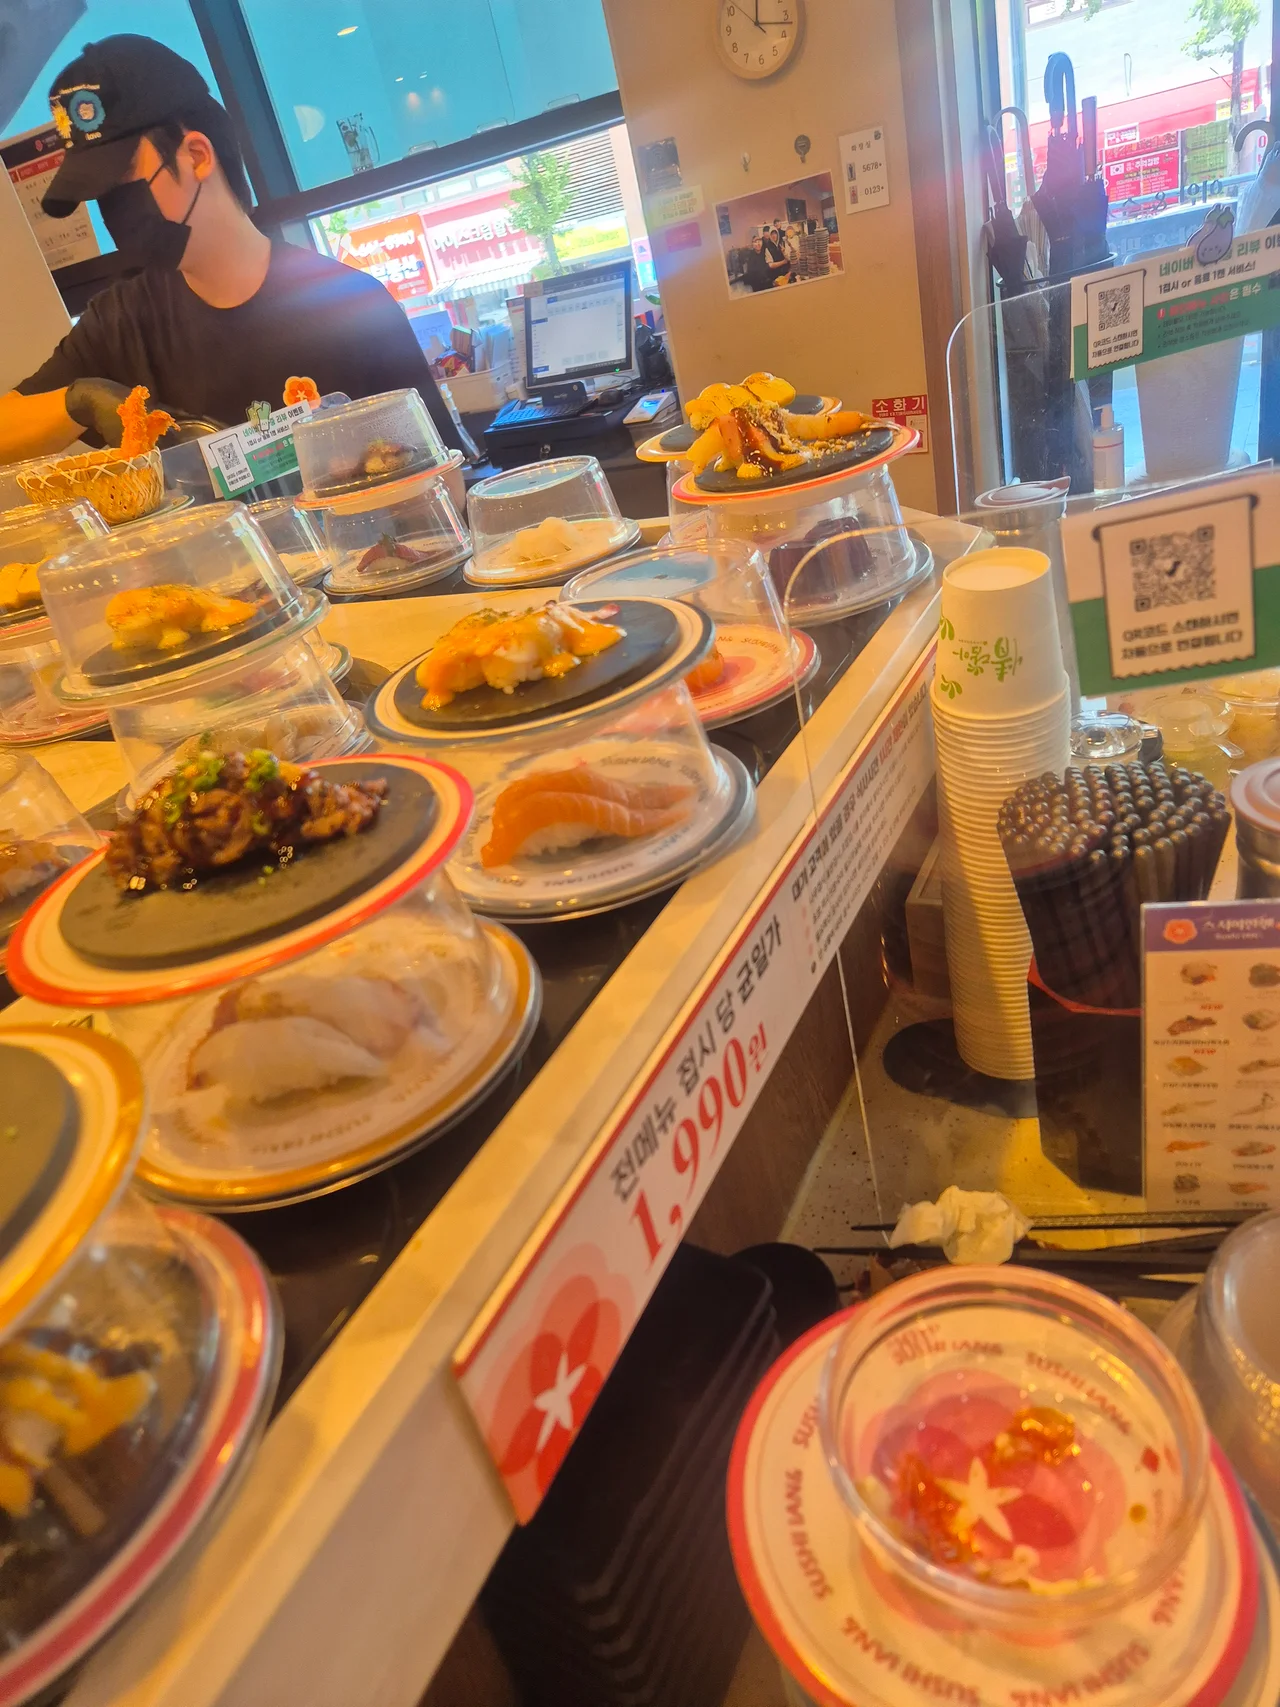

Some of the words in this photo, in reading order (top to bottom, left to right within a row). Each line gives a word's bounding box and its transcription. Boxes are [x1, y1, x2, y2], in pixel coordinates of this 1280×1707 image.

[1160, 255, 1195, 277] 네이버
[1237, 238, 1261, 257] 리뷰
[1159, 279, 1179, 294] 1접시
[1181, 279, 1192, 288] or
[875, 396, 925, 413] 소화기
[609, 1095, 678, 1204] 전메뉴
[676, 1018, 717, 1099] 접시
[716, 987, 738, 1035] 당
[736, 913, 784, 1005] 균일가
